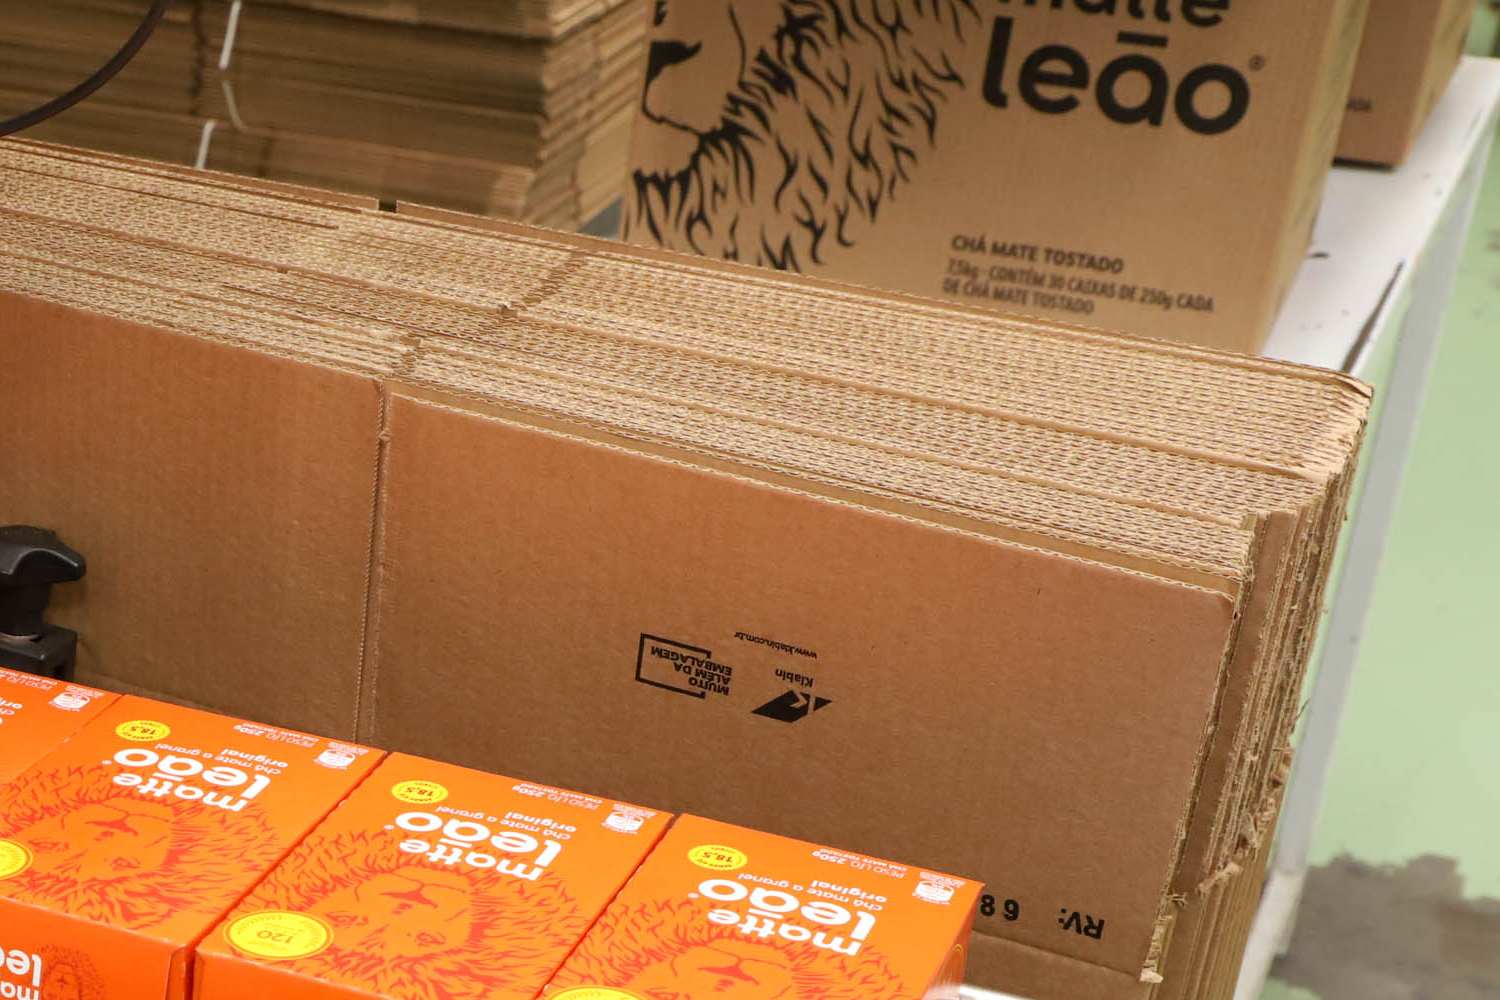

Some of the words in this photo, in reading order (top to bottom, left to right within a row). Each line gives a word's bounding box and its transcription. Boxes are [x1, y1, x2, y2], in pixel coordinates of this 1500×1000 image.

[983, 14, 1250, 135] leão
[952, 234, 987, 254] CHÁ
[991, 242, 1037, 261] MATE
[1044, 248, 1125, 273] TOSTADO
[1033, 290, 1095, 315] TOSTADO
[734, 632, 817, 660] www.klabin.com.br
[651, 646, 732, 676] EMBALAGEM
[673, 662, 692, 674] DA
[688, 677, 729, 696] MUITO
[775, 669, 813, 688] Klabin
[154, 743, 201, 756] granel
[220, 749, 288, 768] original
[114, 748, 270, 799] leão
[214, 756, 252, 768] mate
[112, 773, 248, 812] matte
[436, 806, 484, 820] granel
[505, 812, 576, 832] original
[500, 820, 540, 832] mate
[395, 811, 561, 867] leão
[399, 839, 544, 880] matte
[738, 873, 790, 888] granel
[811, 880, 888, 903] original
[807, 889, 849, 902] mate
[698, 879, 876, 940] leão
[708, 909, 861, 956] matte
[1058, 908, 1105, 939] RV:
